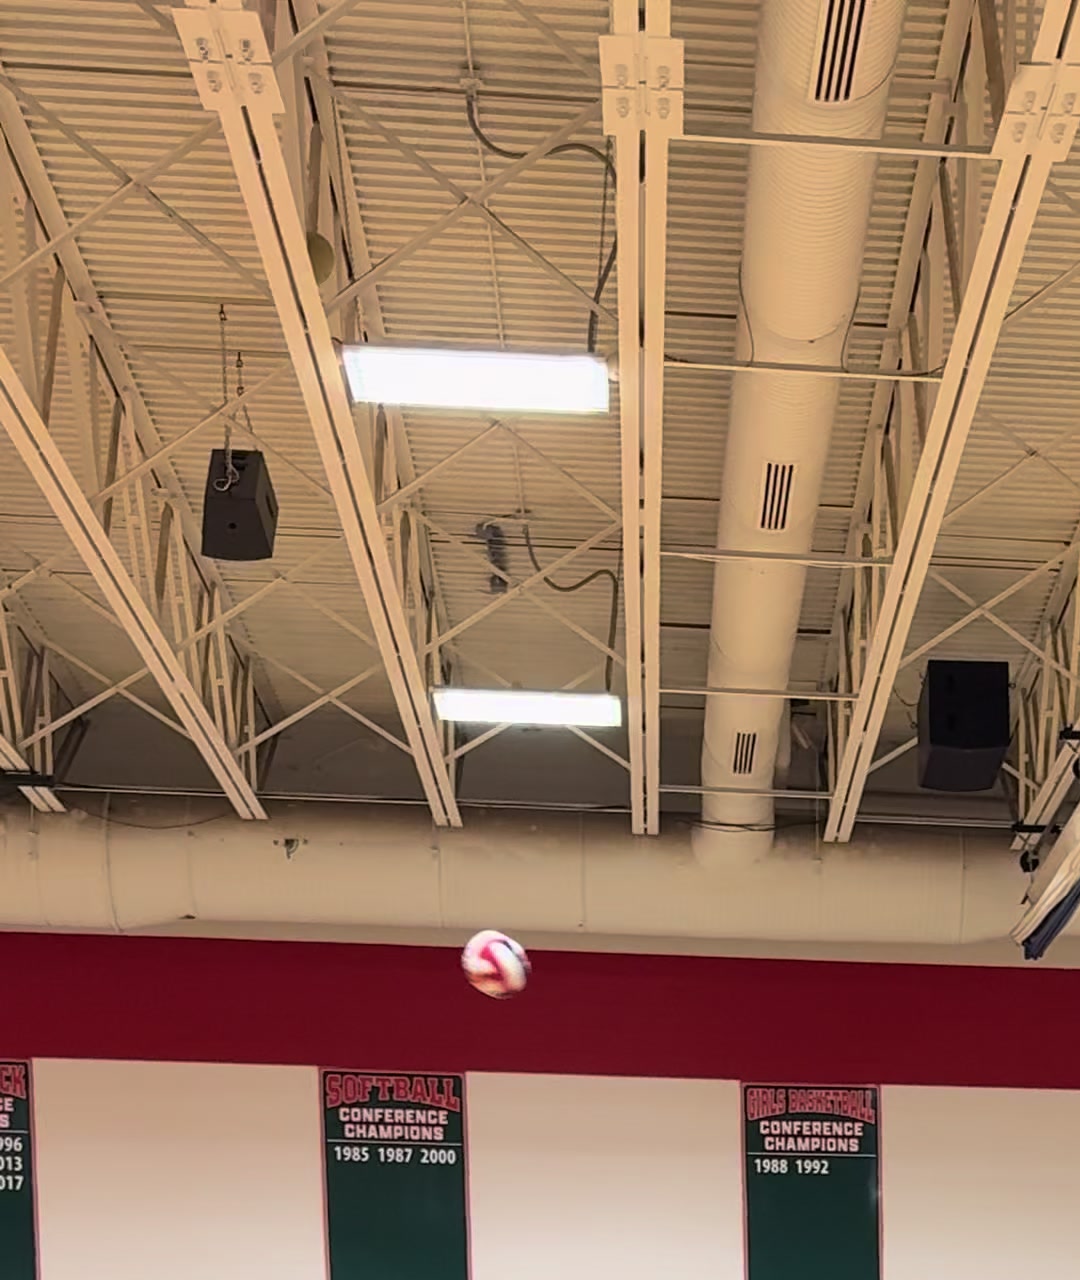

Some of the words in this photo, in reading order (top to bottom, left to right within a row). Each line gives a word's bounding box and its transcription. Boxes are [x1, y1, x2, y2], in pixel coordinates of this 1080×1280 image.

[326, 1074, 461, 1112] SOFTBALL
[747, 1088, 786, 1121] GIRLS
[788, 1089, 875, 1125] BASKETBALL
[339, 1107, 449, 1124] CONFERENCE
[344, 1124, 444, 1141] CHAMPIONS
[760, 1121, 864, 1136] CONFERENCE
[0, 1137, 22, 1152] 96
[764, 1137, 859, 1152] CHAMPIONS
[334, 1146, 369, 1161] 1985
[378, 1148, 413, 1163] 1987
[420, 1149, 456, 1164] 2000
[0, 1156, 23, 1171] 013
[754, 1159, 788, 1174] 1988
[796, 1160, 829, 1174] 1992
[0, 1175, 24, 1190] 017
